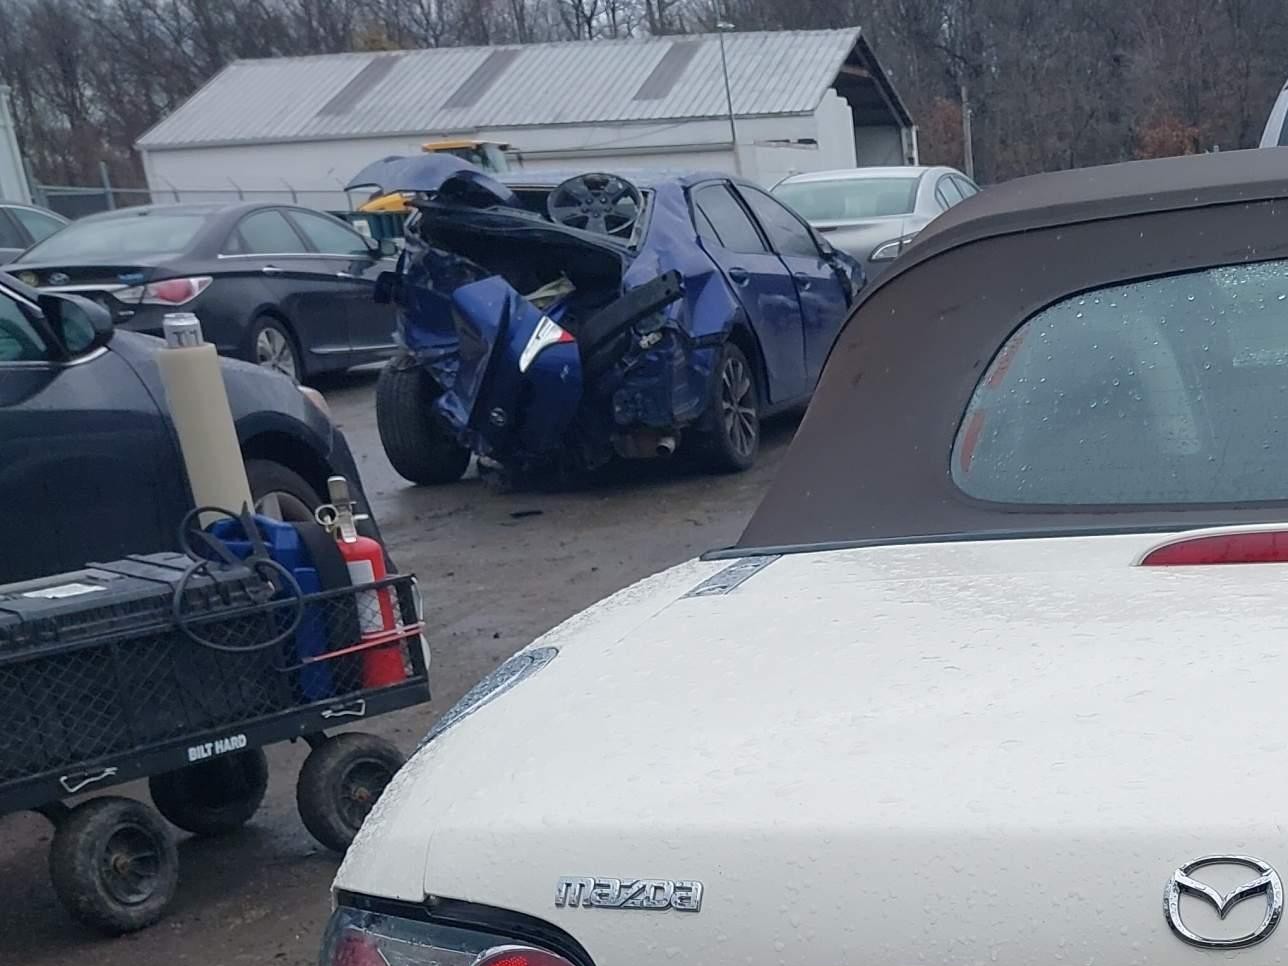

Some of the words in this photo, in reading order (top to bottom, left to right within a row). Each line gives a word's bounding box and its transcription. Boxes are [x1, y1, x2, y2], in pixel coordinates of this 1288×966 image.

[187, 741, 214, 762] BILT
[214, 733, 247, 755] HARD
[554, 876, 704, 913] mazda
